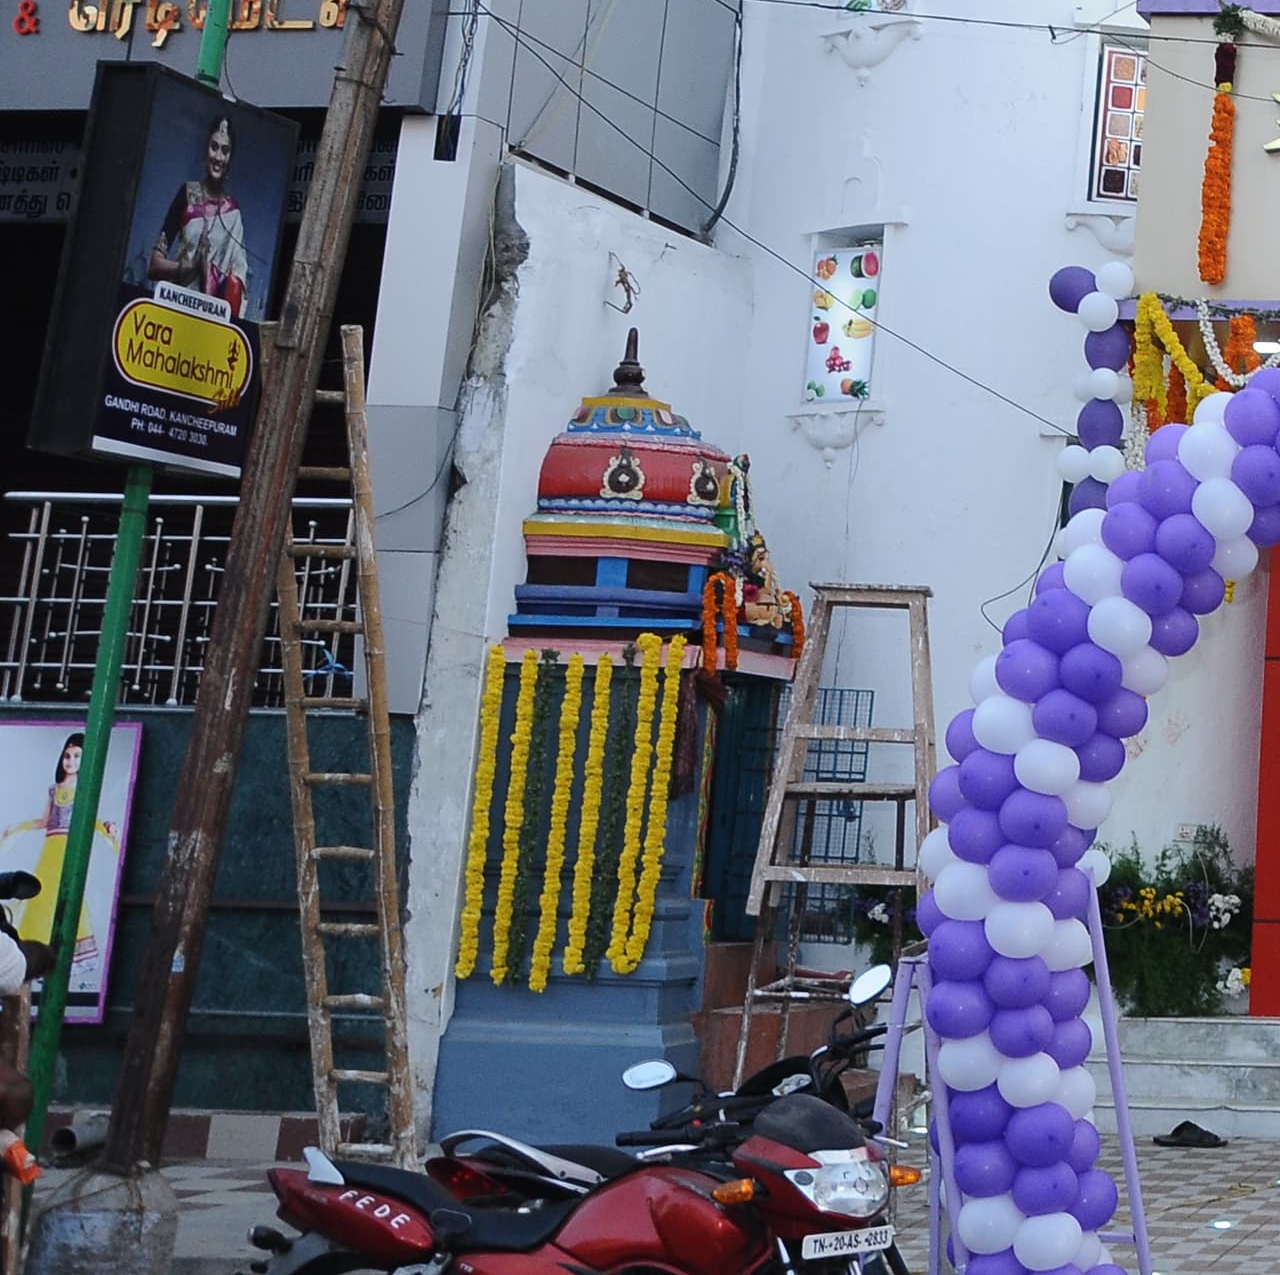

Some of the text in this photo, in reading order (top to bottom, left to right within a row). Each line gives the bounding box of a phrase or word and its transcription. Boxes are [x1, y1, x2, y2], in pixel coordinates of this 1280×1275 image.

[159, 287, 227, 319] KANCHEEPURAM
[133, 311, 173, 346] Vara
[126, 338, 234, 389] Mahalakshmi
[105, 394, 139, 413] GANDHI
[169, 411, 238, 436] KANCHEEPURAM
[338, 1189, 411, 1230] FEDE
